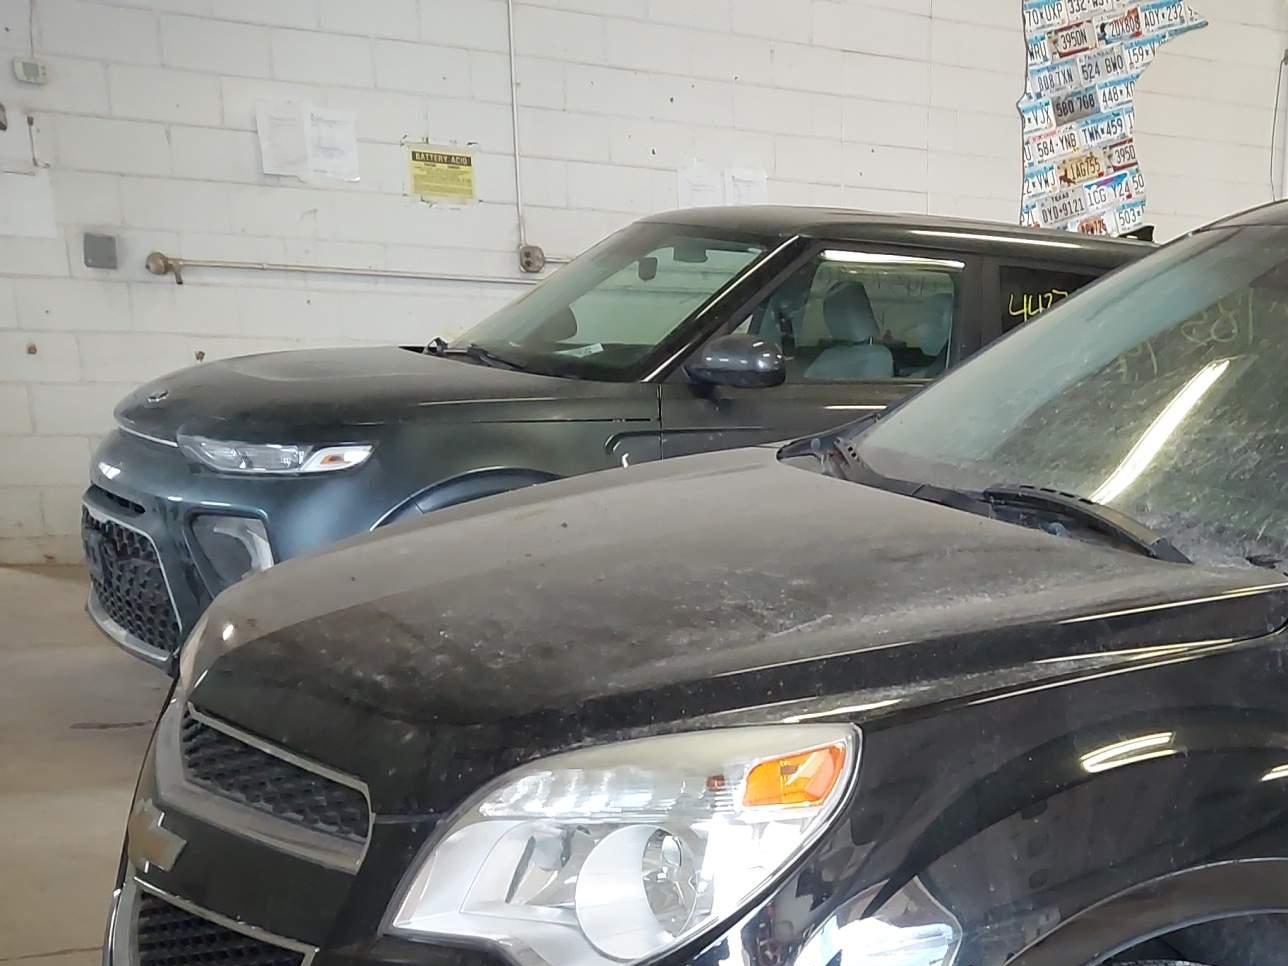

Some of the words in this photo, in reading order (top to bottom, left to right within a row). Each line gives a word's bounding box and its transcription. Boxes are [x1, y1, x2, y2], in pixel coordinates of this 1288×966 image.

[1081, 61, 1101, 81] 524
[415, 152, 448, 162] BATTERY
[451, 156, 468, 165] ACID
